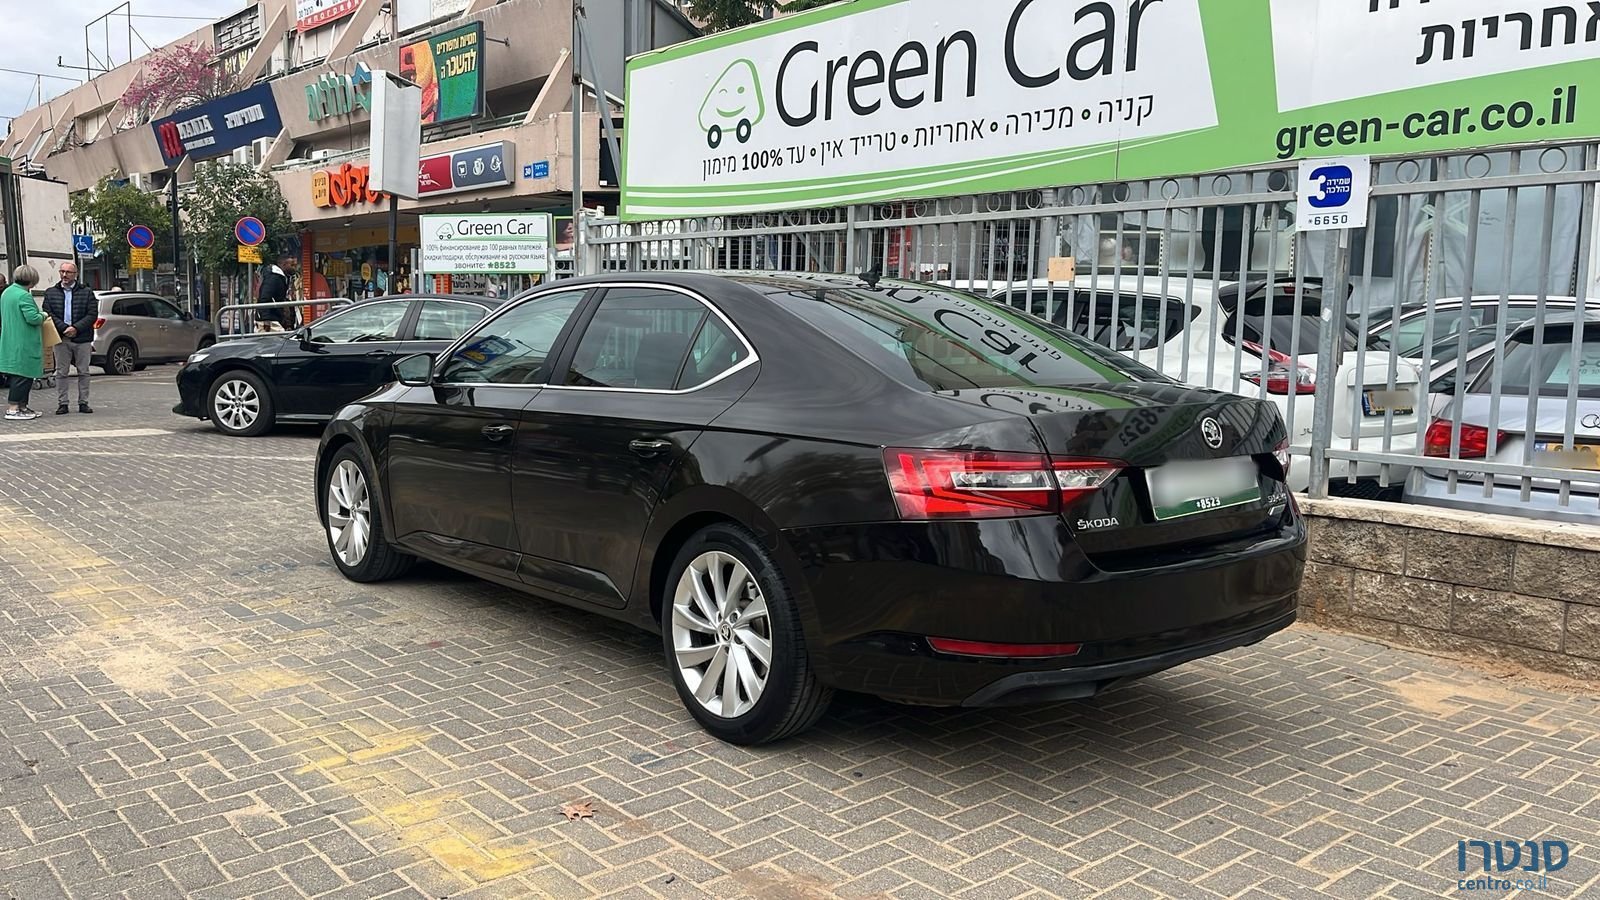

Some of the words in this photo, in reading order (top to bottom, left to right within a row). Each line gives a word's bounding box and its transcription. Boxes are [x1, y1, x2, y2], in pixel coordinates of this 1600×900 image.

[776, 29, 977, 127] Green
[1004, 0, 1161, 88] Car
[1005, 105, 1073, 137] מכירה
[1097, 95, 1154, 128] קניה
[1276, 85, 1577, 159] green-car.co.il
[849, 130, 896, 156] טרייד
[913, 118, 985, 149] אחריות
[742, 148, 783, 172] 100%
[787, 145, 805, 165] עד
[821, 140, 843, 166] אין
[703, 155, 736, 181] מימון
[1326, 178, 1351, 186] שמירה
[1326, 185, 1350, 194] כהלכה
[457, 219, 503, 235] Green
[506, 219, 533, 235] Car
[1077, 516, 1120, 530] ŠKODA
